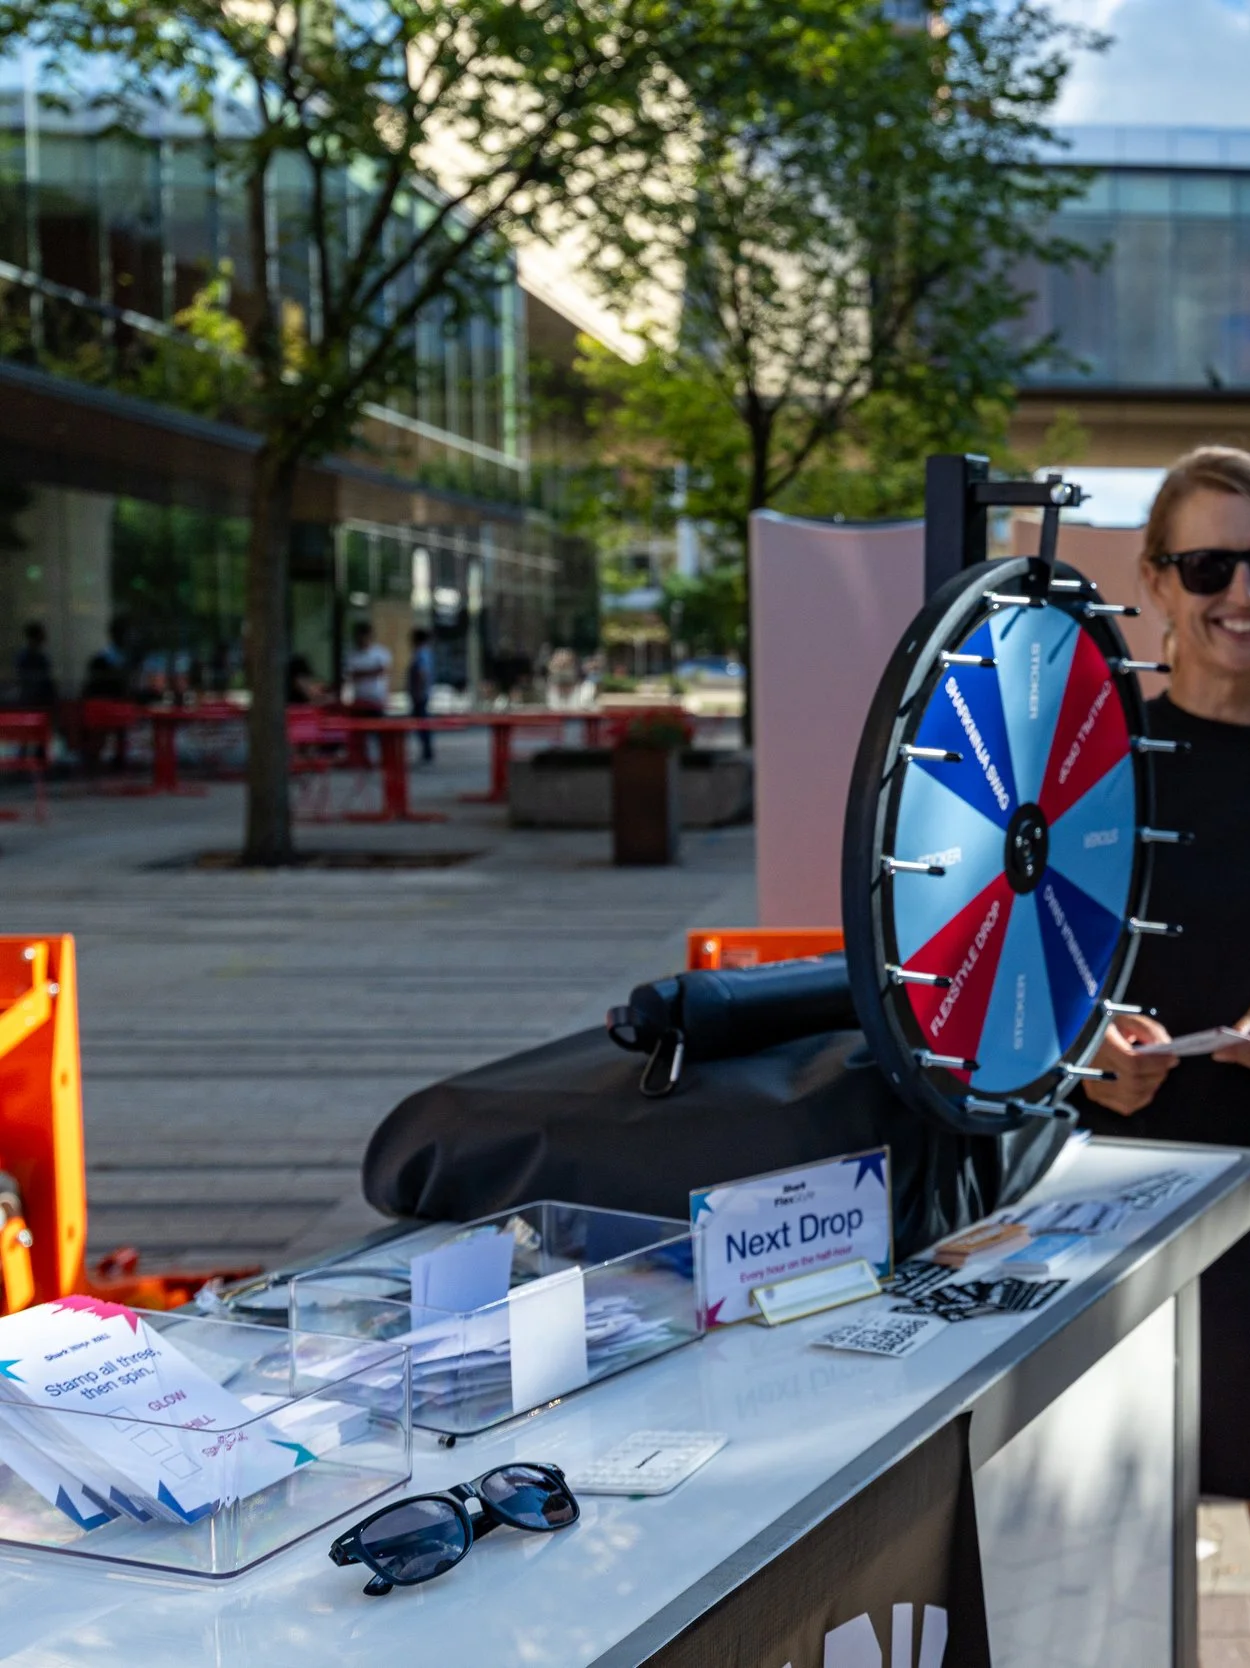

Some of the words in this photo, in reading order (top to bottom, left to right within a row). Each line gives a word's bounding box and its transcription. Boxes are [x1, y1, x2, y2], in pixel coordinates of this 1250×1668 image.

[1029, 642, 1041, 720] STICKER
[945, 676, 991, 771] SHARKNINJA
[986, 764, 1010, 811] SWAG
[930, 945, 979, 1037] FLEXSTYLE
[975, 900, 1000, 950] DROP
[726, 1220, 791, 1263] Next
[799, 1208, 864, 1244] Drop
[44, 1371, 98, 1397] Stamp
[99, 1361, 118, 1376] all
[116, 1347, 162, 1367] three,
[80, 1380, 119, 1400] then
[118, 1366, 155, 1385] spin.
[148, 1389, 187, 1412] GLOW
